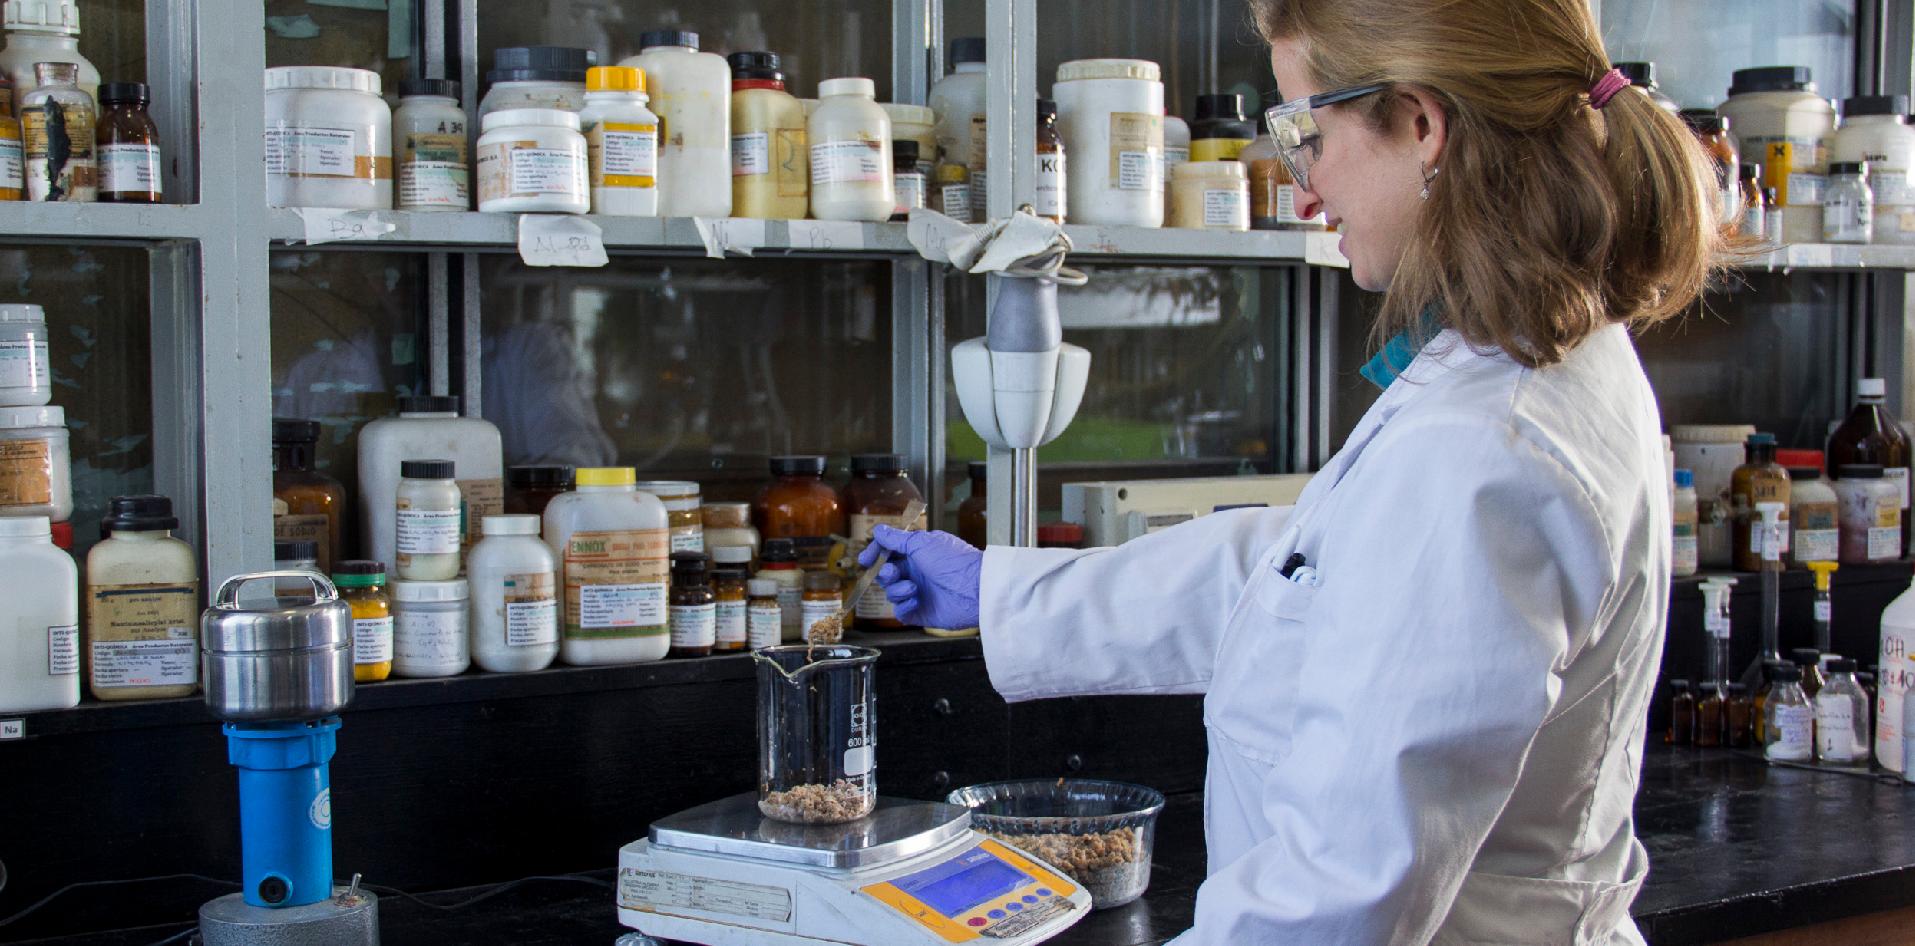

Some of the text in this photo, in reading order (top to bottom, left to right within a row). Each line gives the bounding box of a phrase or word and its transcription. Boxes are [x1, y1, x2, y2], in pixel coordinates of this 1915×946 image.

[437, 121, 446, 134] A
[4, 725, 18, 735] Na
[847, 738, 862, 747] 600
